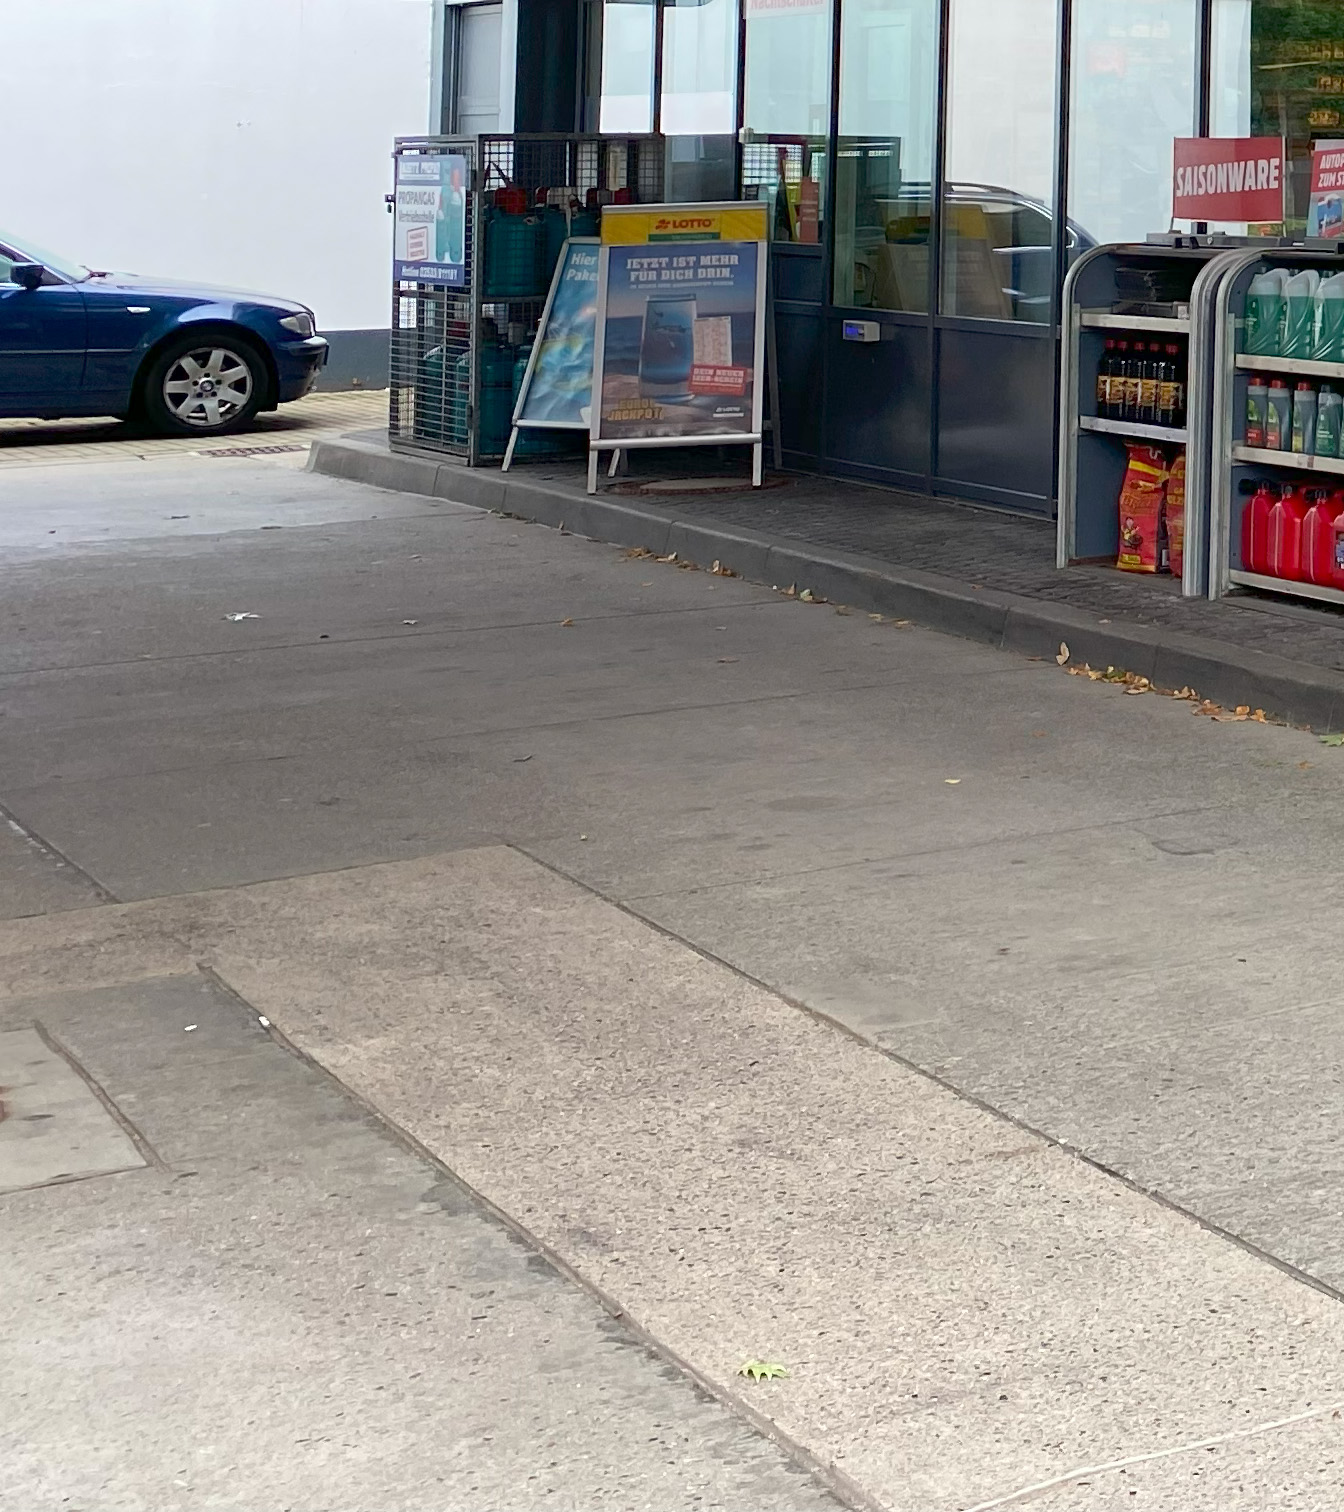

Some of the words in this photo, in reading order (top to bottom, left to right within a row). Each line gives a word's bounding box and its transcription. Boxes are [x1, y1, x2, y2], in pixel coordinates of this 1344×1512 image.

[1176, 157, 1280, 197] SAISONWARE
[1317, 171, 1337, 187] ZUM
[672, 218, 713, 229] LOTTO
[571, 252, 598, 266] Hier
[626, 256, 668, 269] JETZT
[672, 255, 696, 267] IST
[700, 254, 739, 266] MEHR
[630, 267, 658, 282] FÜR
[661, 268, 694, 281] DICH
[607, 407, 661, 422] JACKPOT
